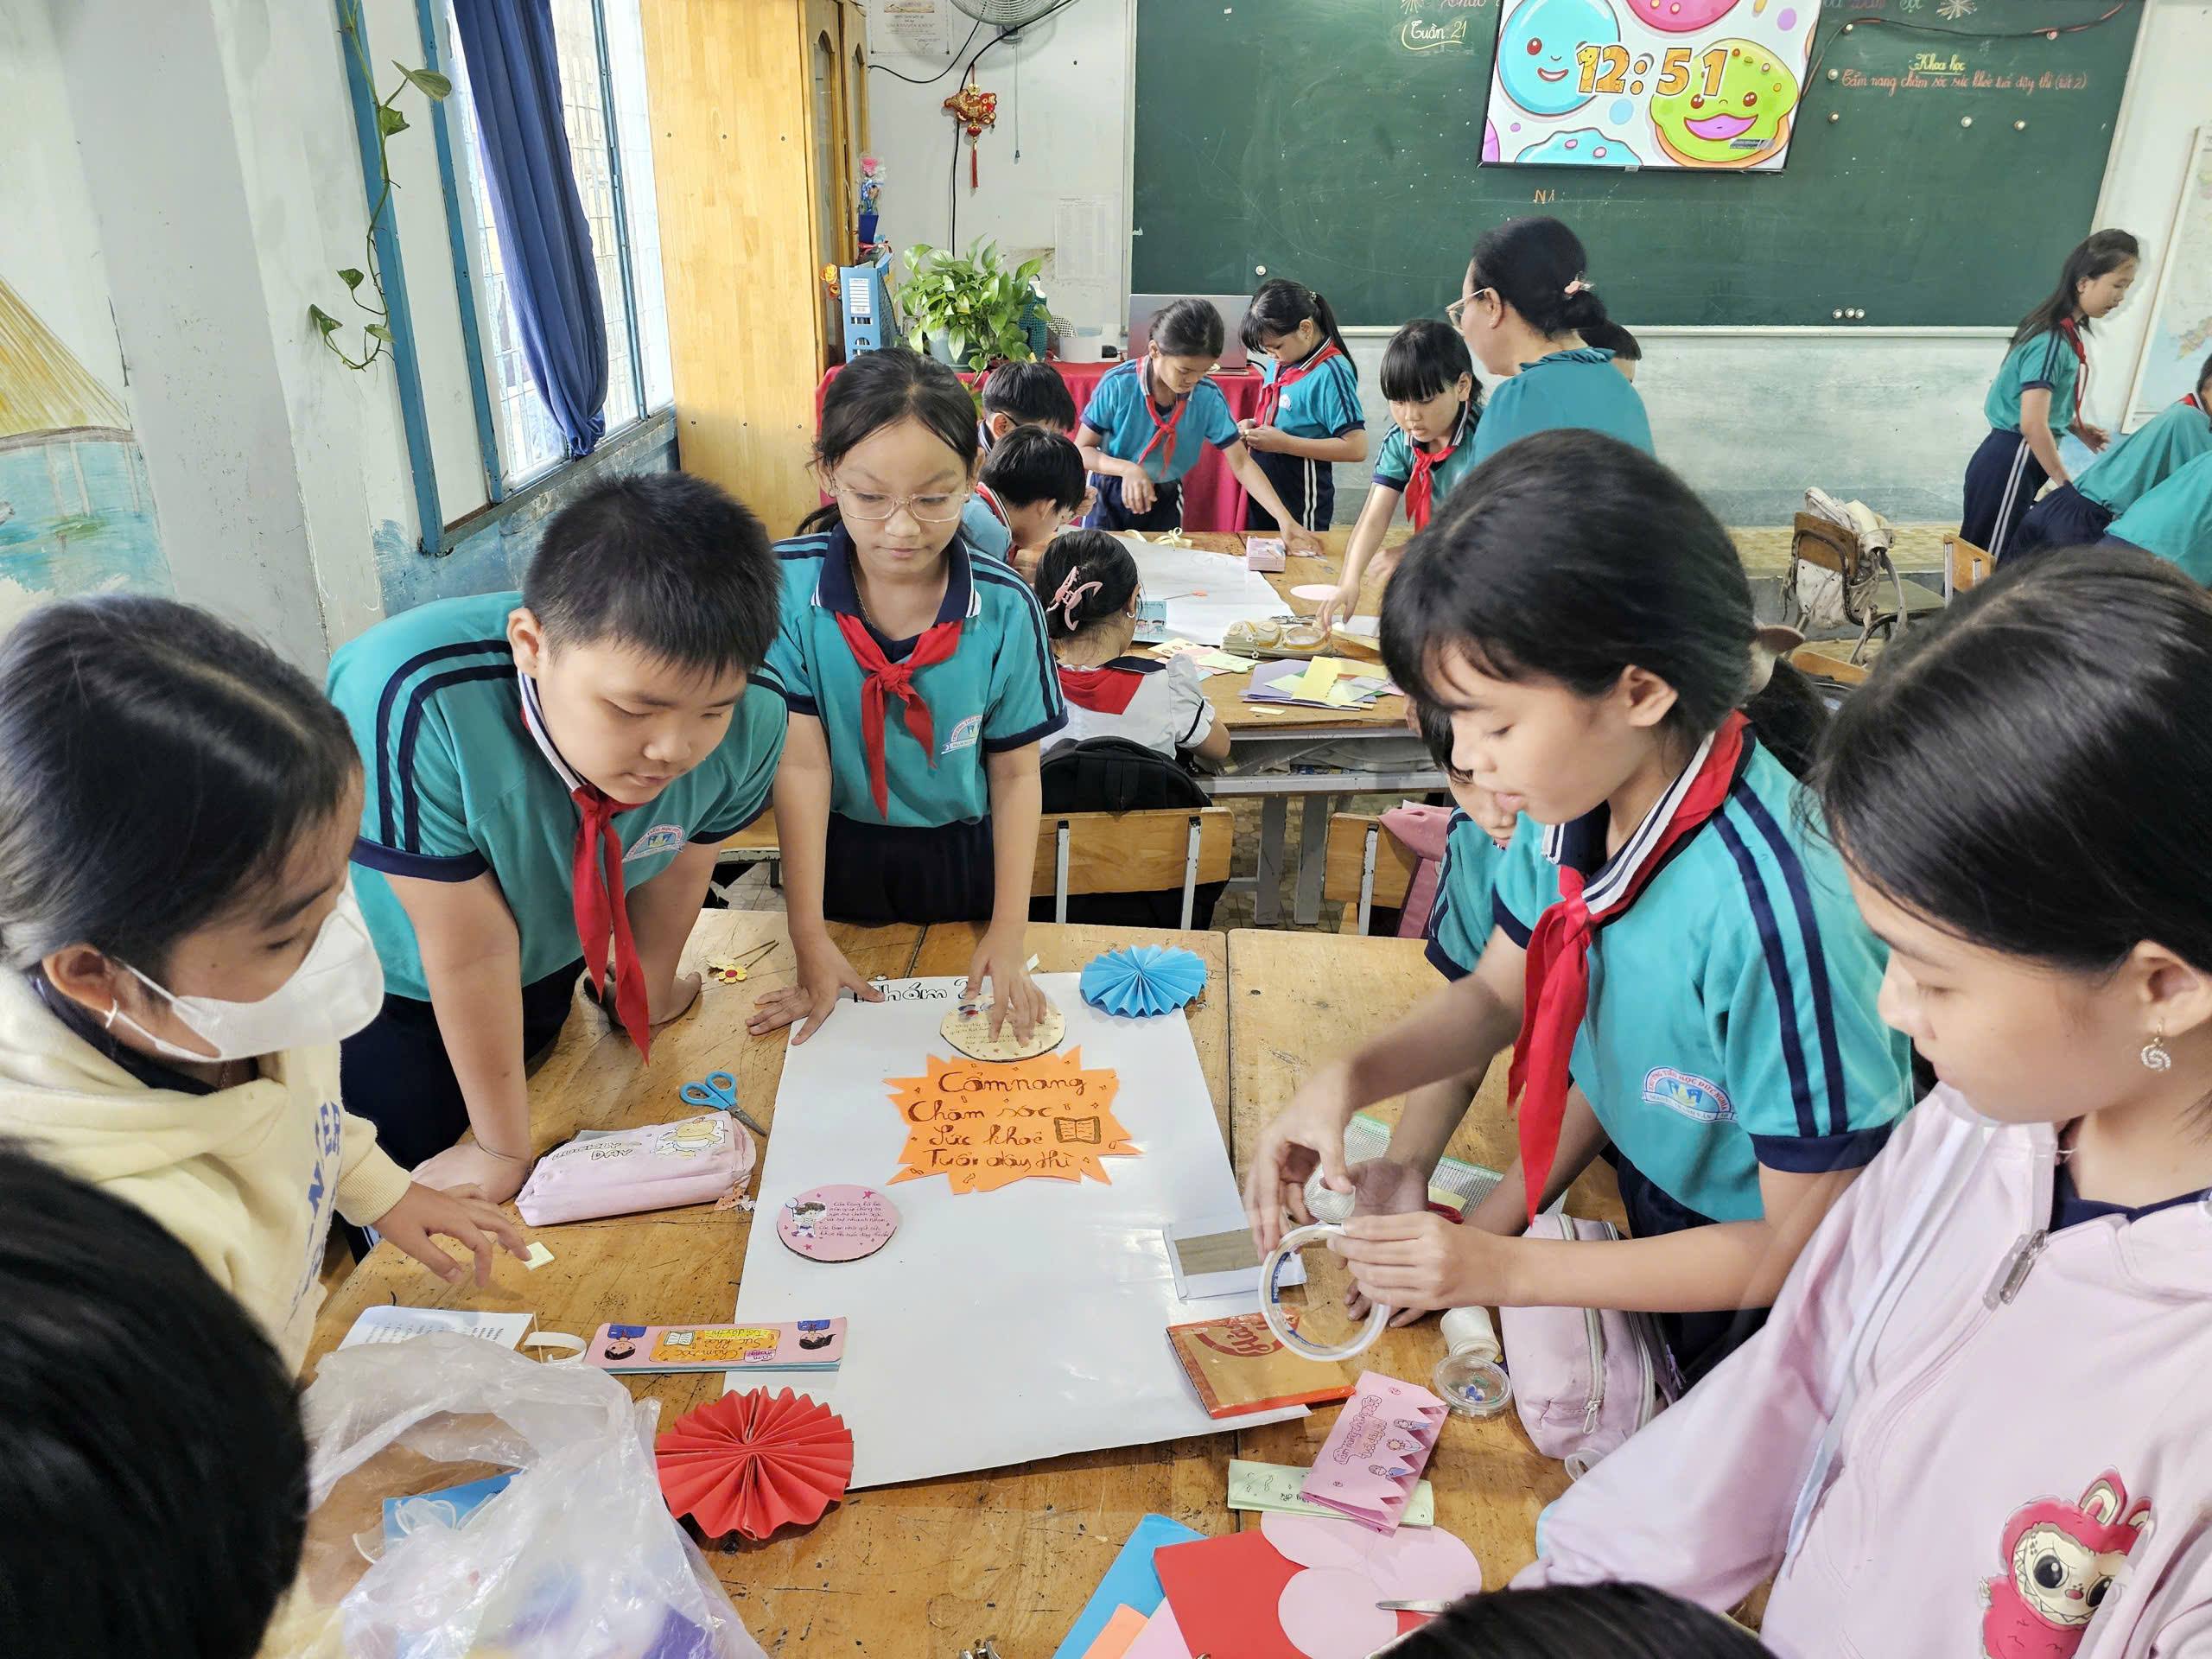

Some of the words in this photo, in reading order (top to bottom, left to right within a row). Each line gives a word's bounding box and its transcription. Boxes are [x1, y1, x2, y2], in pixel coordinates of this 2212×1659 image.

[1450, 20, 1467, 39] 21
[1908, 53, 1946, 71] Khoa
[1871, 77, 1897, 97] nang
[1012, 1077, 1086, 1096] nang
